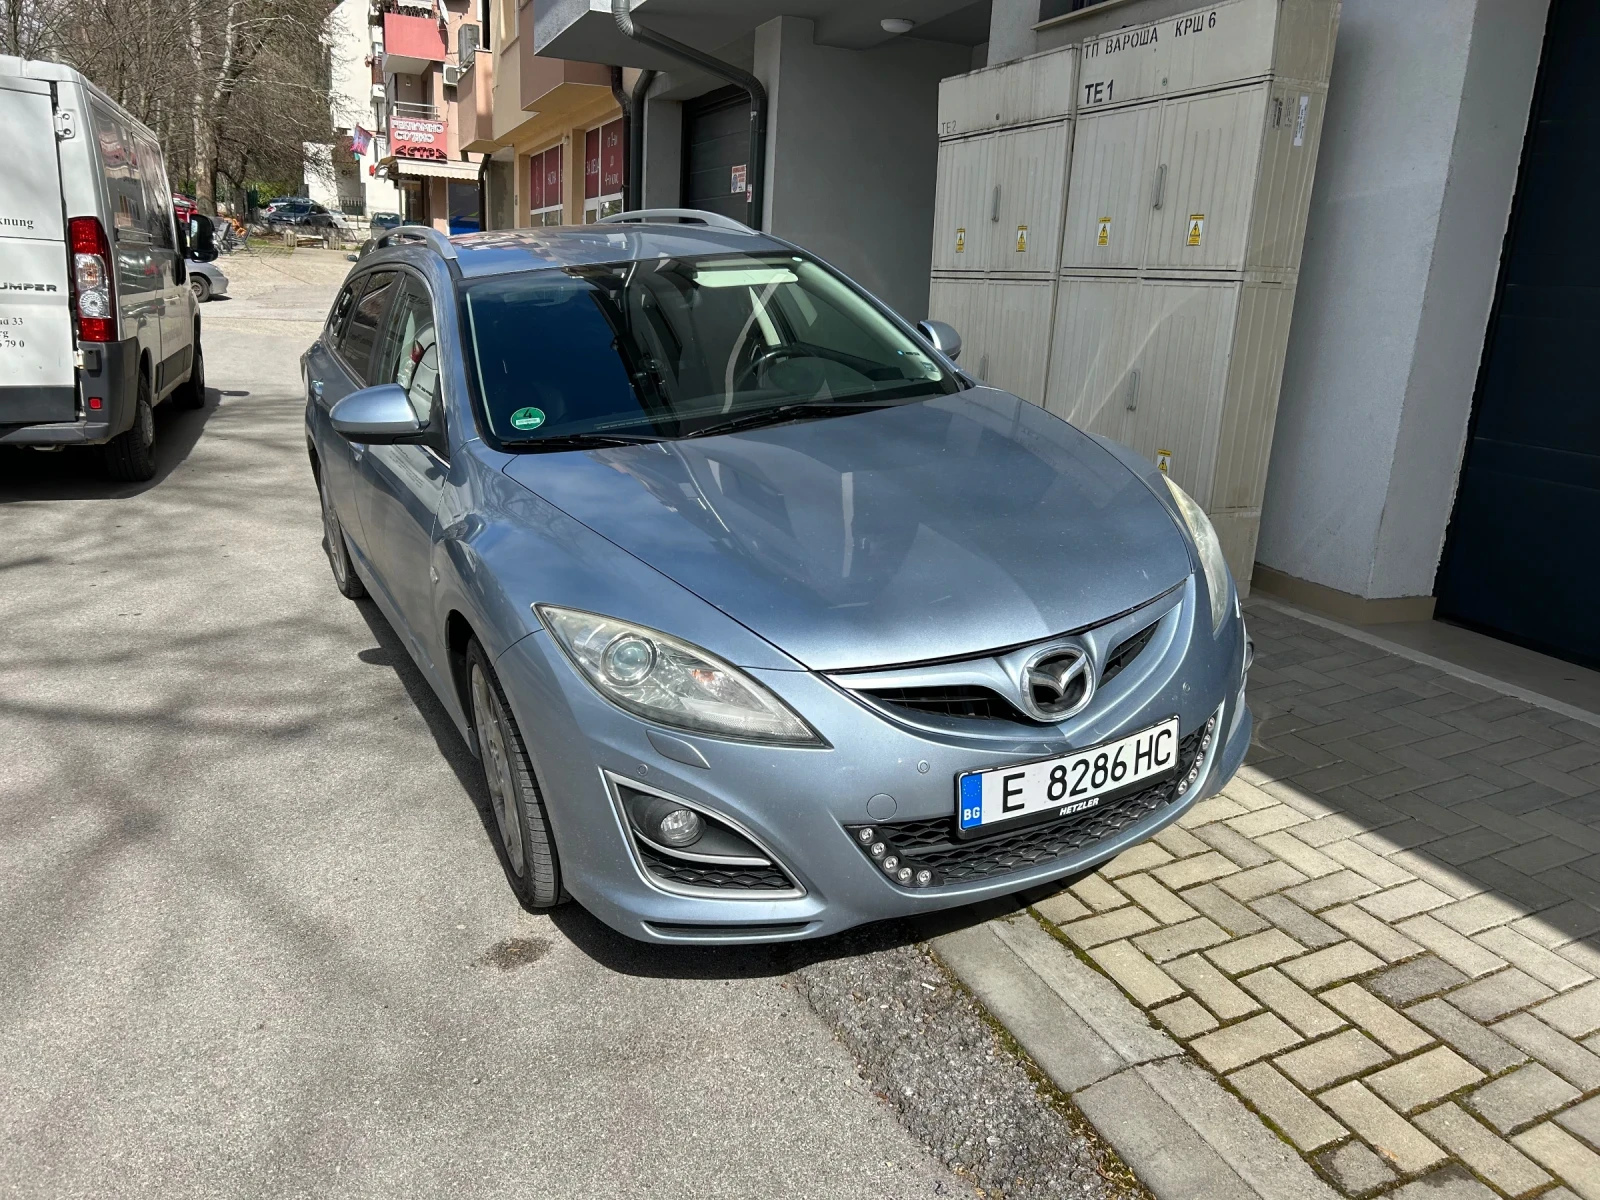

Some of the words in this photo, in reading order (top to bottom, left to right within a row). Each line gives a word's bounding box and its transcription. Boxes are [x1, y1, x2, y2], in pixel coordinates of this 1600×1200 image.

[1084, 42, 1099, 59] ТП
[1105, 27, 1158, 54] ВАРОША
[1175, 15, 1204, 38] КРШ
[1208, 12, 1217, 29] 6
[12, 317, 23, 326] 33
[523, 407, 532, 419] 4
[1002, 772, 1026, 813] E
[1047, 745, 1127, 801] 8286
[1134, 728, 1172, 775] HC
[963, 806, 981, 821] BG
[1059, 797, 1100, 816] HETZLER
